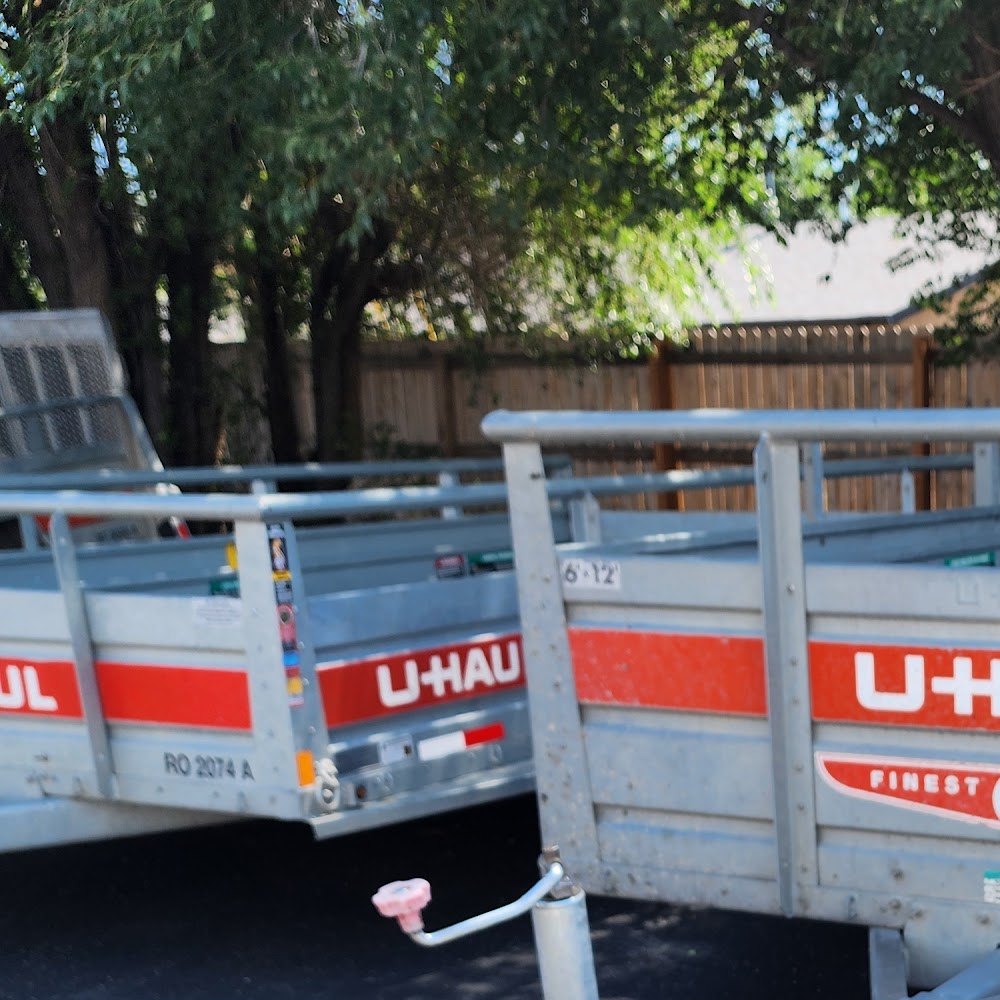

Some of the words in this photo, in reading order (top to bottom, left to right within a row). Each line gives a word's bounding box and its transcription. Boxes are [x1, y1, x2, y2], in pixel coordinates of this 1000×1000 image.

[163, 751, 191, 776] RO
[194, 754, 236, 779] 2074
[240, 757, 255, 782] A
[869, 769, 980, 796] FINEST
